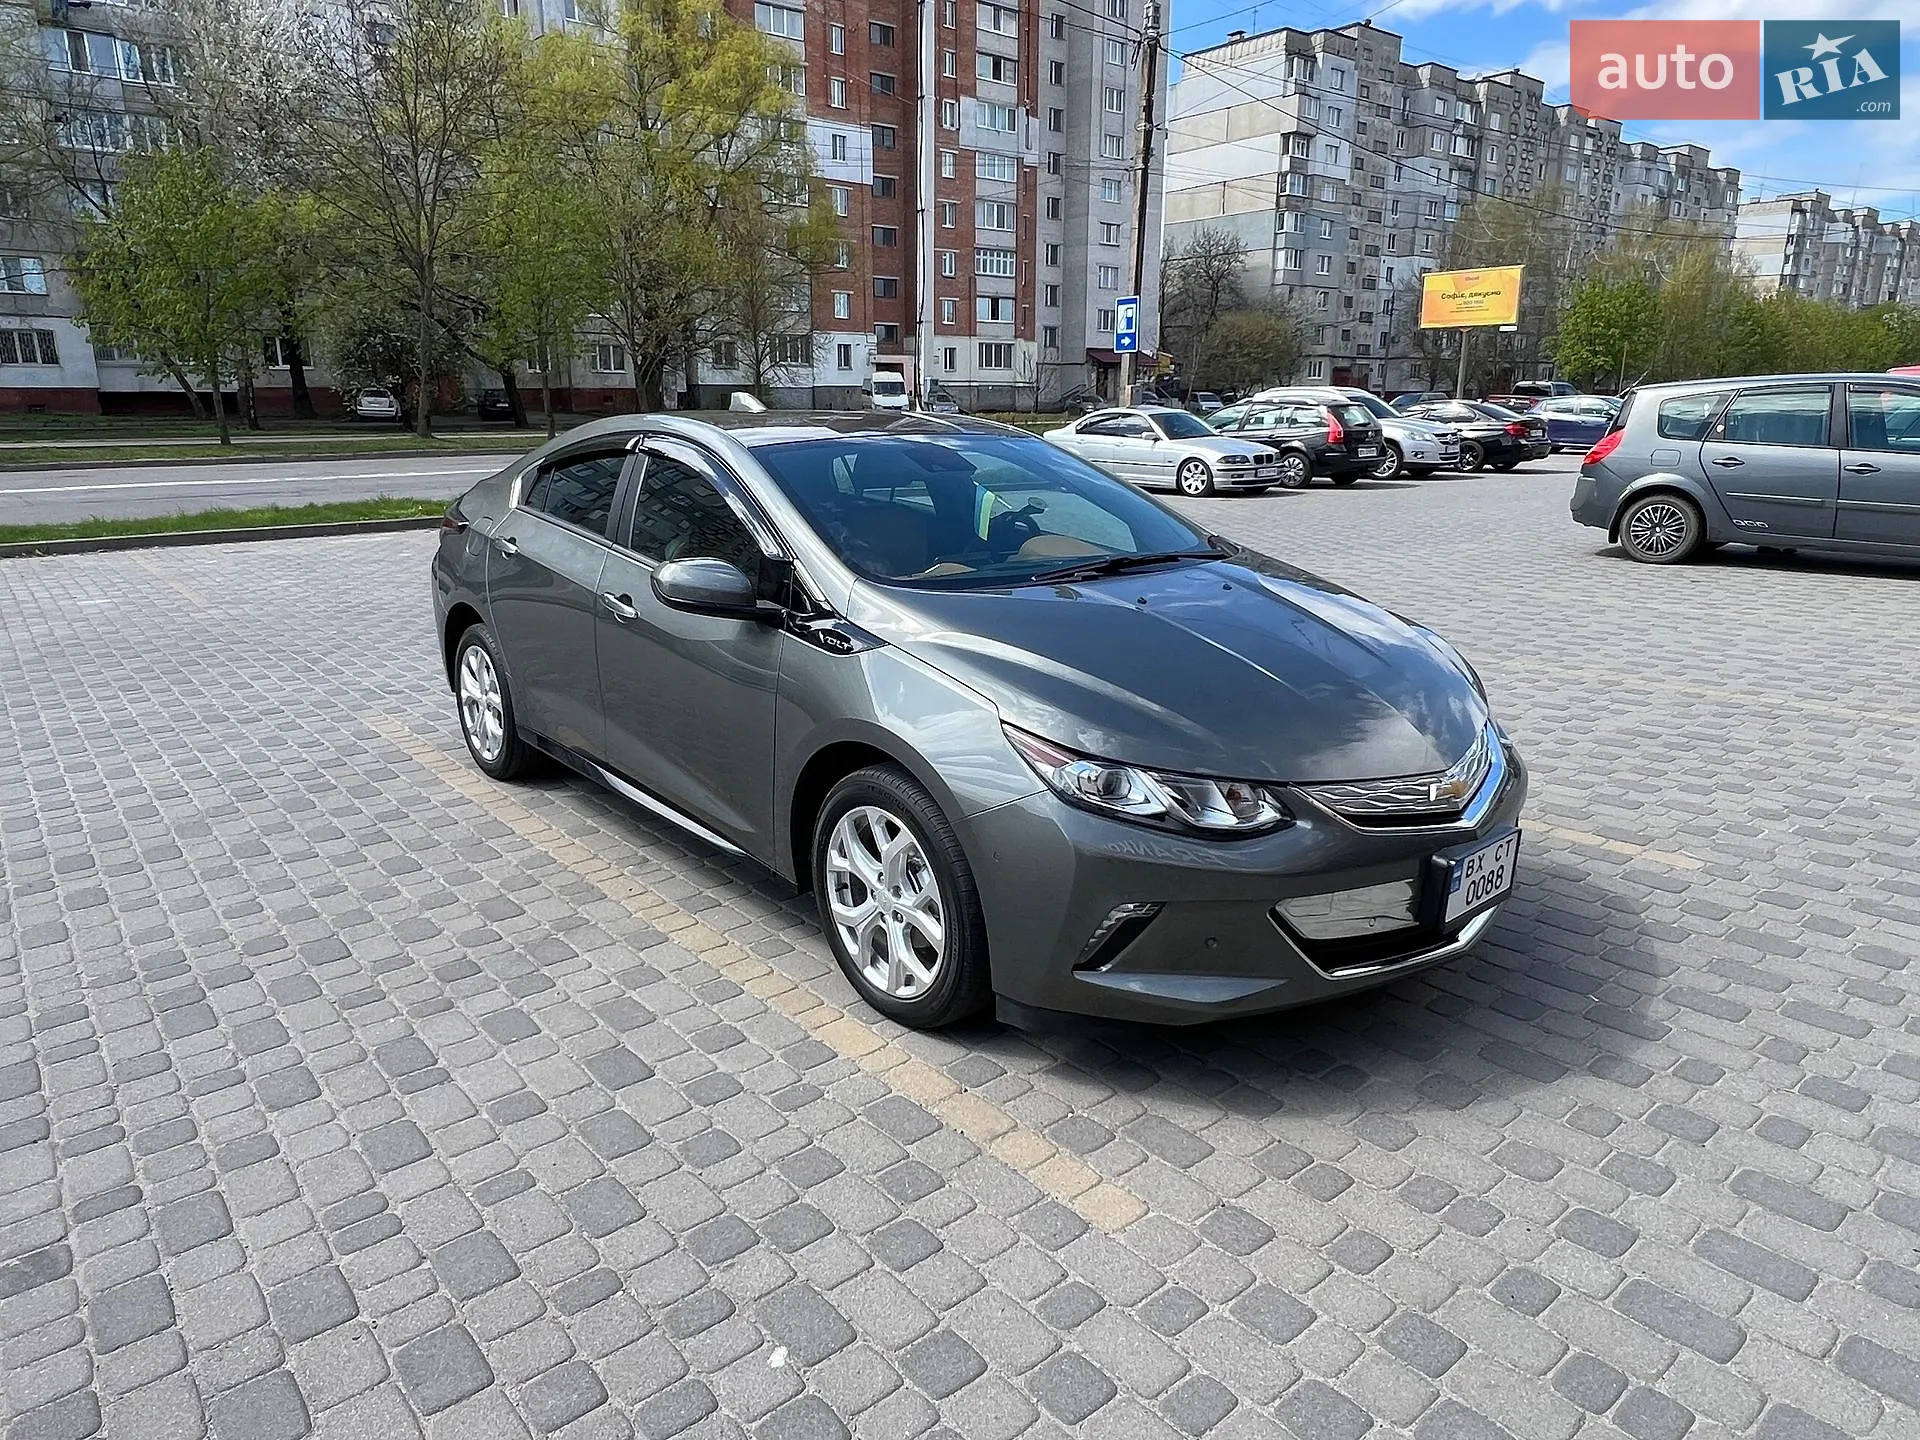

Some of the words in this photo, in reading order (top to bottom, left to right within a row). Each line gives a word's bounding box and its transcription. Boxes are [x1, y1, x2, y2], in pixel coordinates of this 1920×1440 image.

[819, 630, 852, 650] VOLT
[1465, 853, 1485, 878] BX
[1495, 839, 1514, 862] CT
[1466, 864, 1504, 906] 0088
